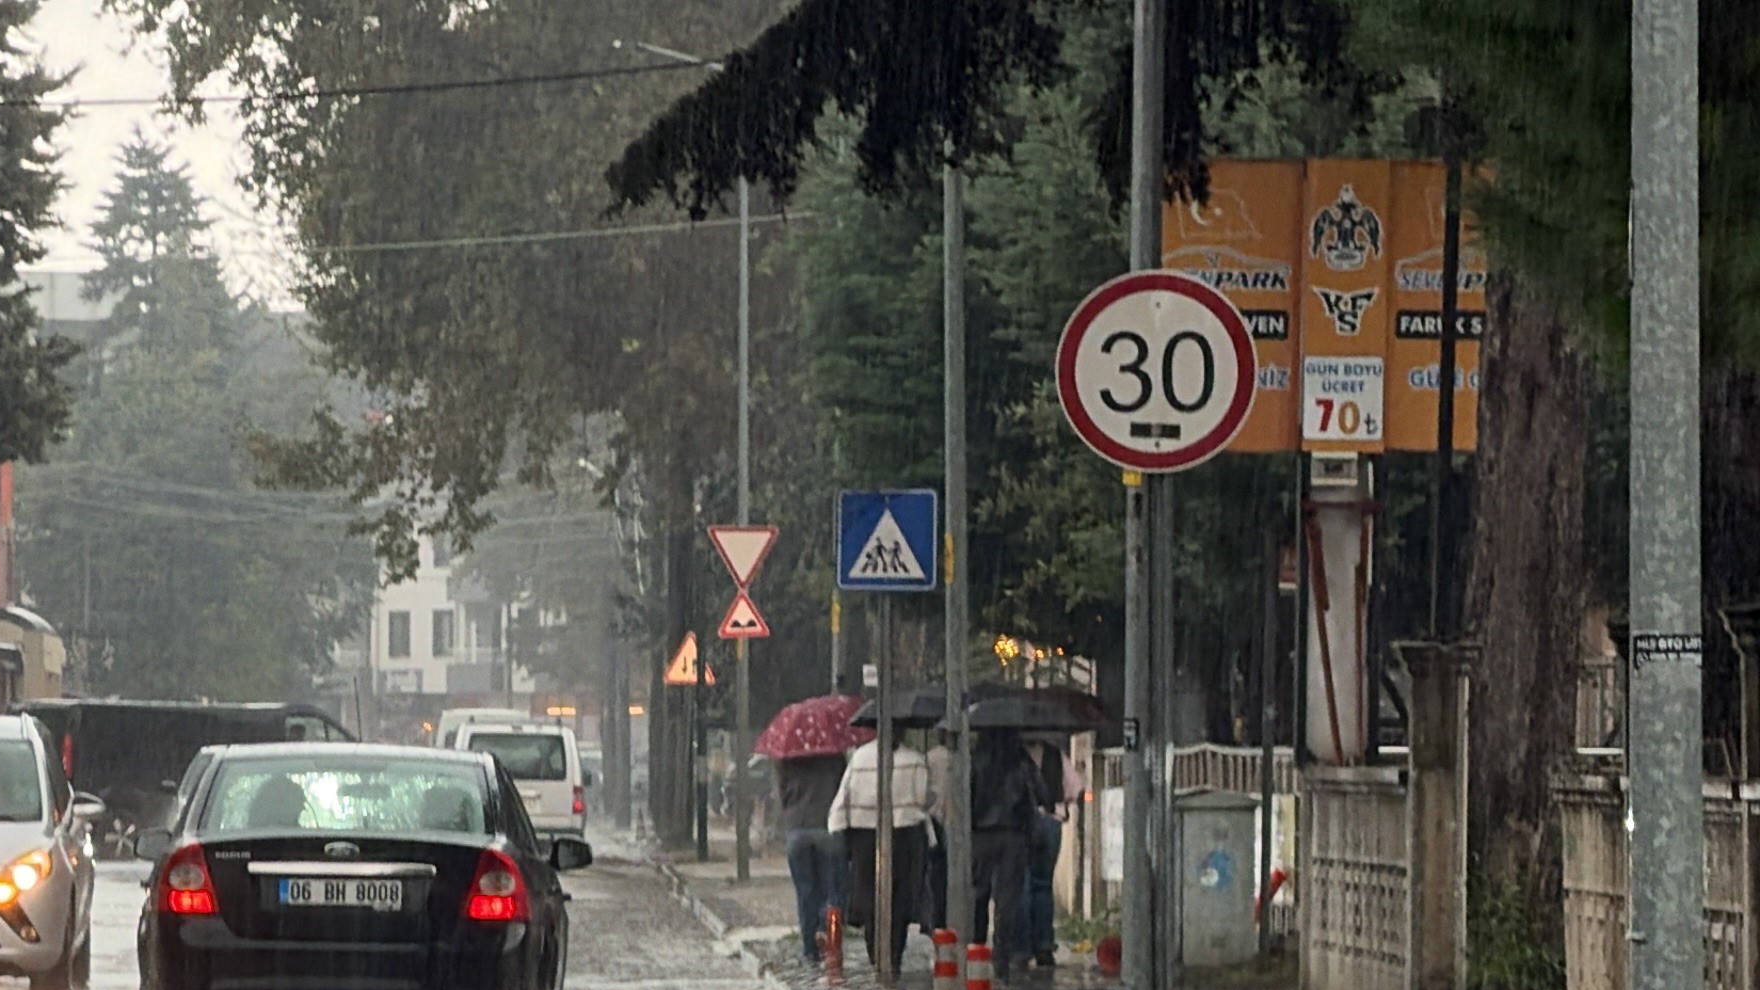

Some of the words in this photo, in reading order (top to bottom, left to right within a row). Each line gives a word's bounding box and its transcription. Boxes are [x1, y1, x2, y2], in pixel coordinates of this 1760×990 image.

[1100, 330, 1215, 413] 30
[1306, 360, 1338, 376] GÜN
[1344, 362, 1382, 377] BOYU
[1322, 379, 1365, 393] ÜCRET
[290, 880, 311, 901] 06
[324, 880, 346, 901] BH
[356, 881, 400, 902] 8008
